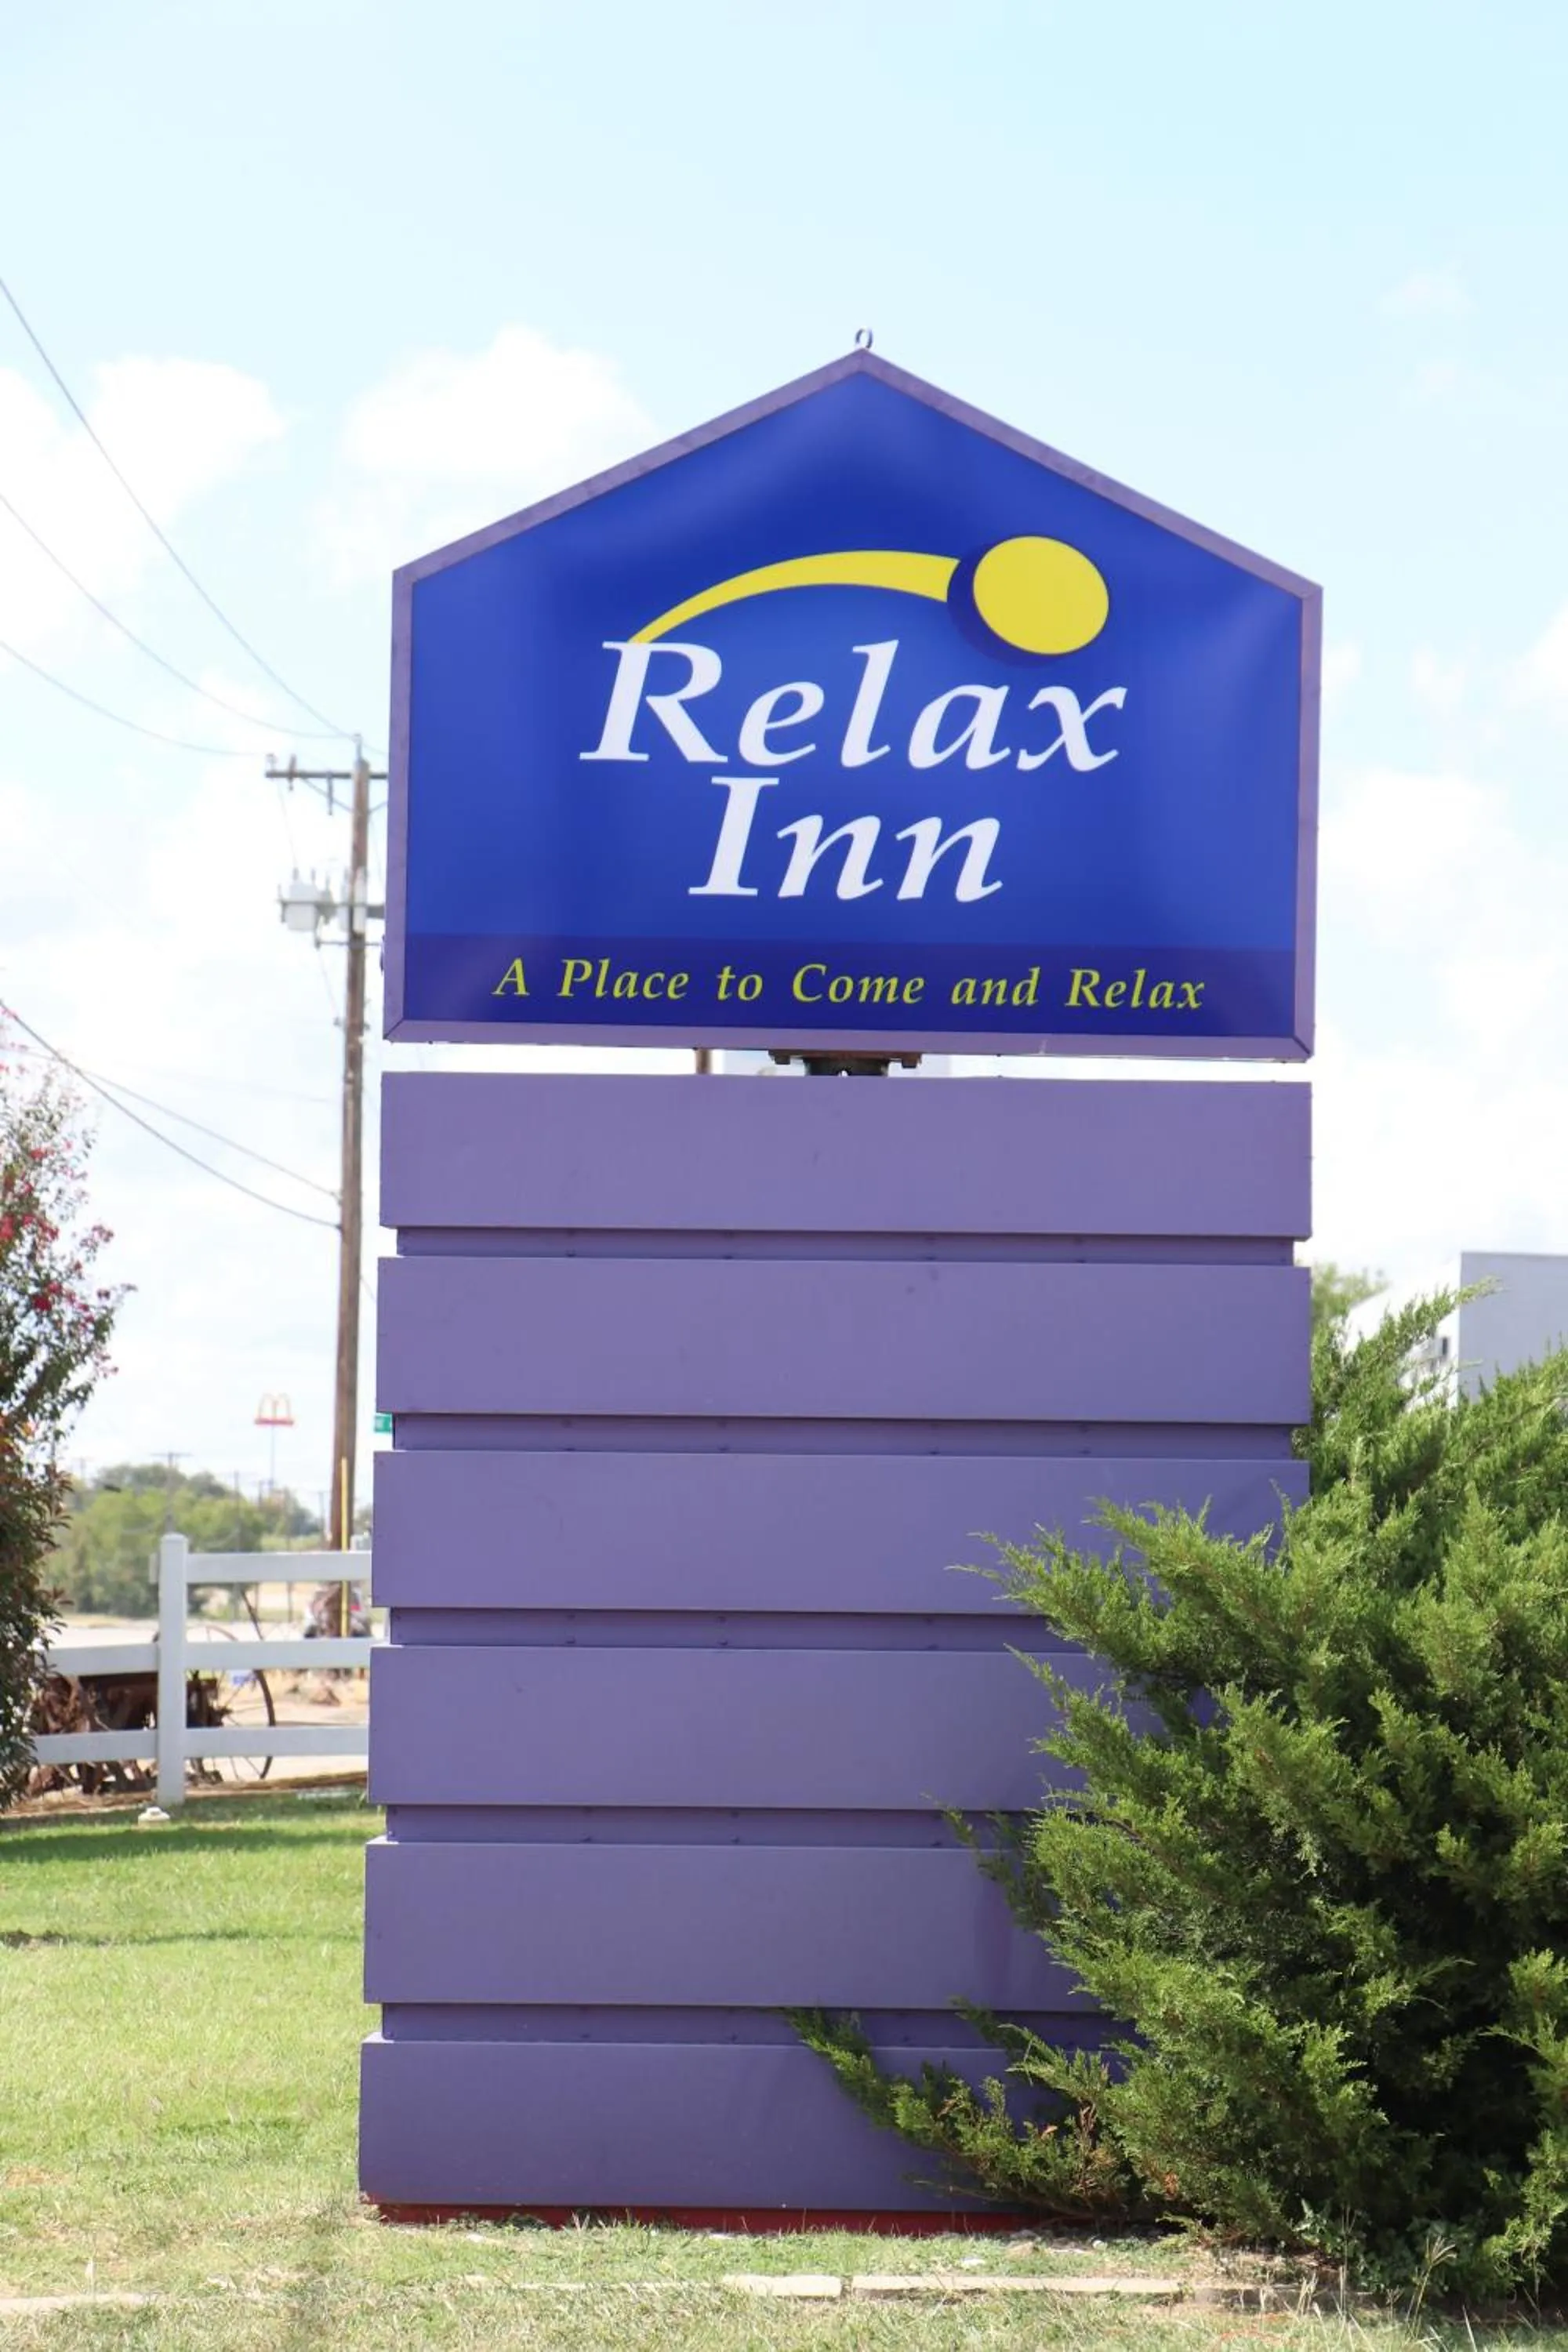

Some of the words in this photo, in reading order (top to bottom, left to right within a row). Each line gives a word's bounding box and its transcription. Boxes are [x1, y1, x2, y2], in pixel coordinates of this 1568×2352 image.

[579, 638, 1127, 772] Relax
[688, 775, 1004, 902] Inn
[492, 957, 529, 996] A
[557, 958, 689, 1000] Place
[717, 965, 764, 1001] to
[792, 963, 925, 1004] Come
[950, 966, 1041, 1007] and
[1065, 968, 1206, 1010] Relax
